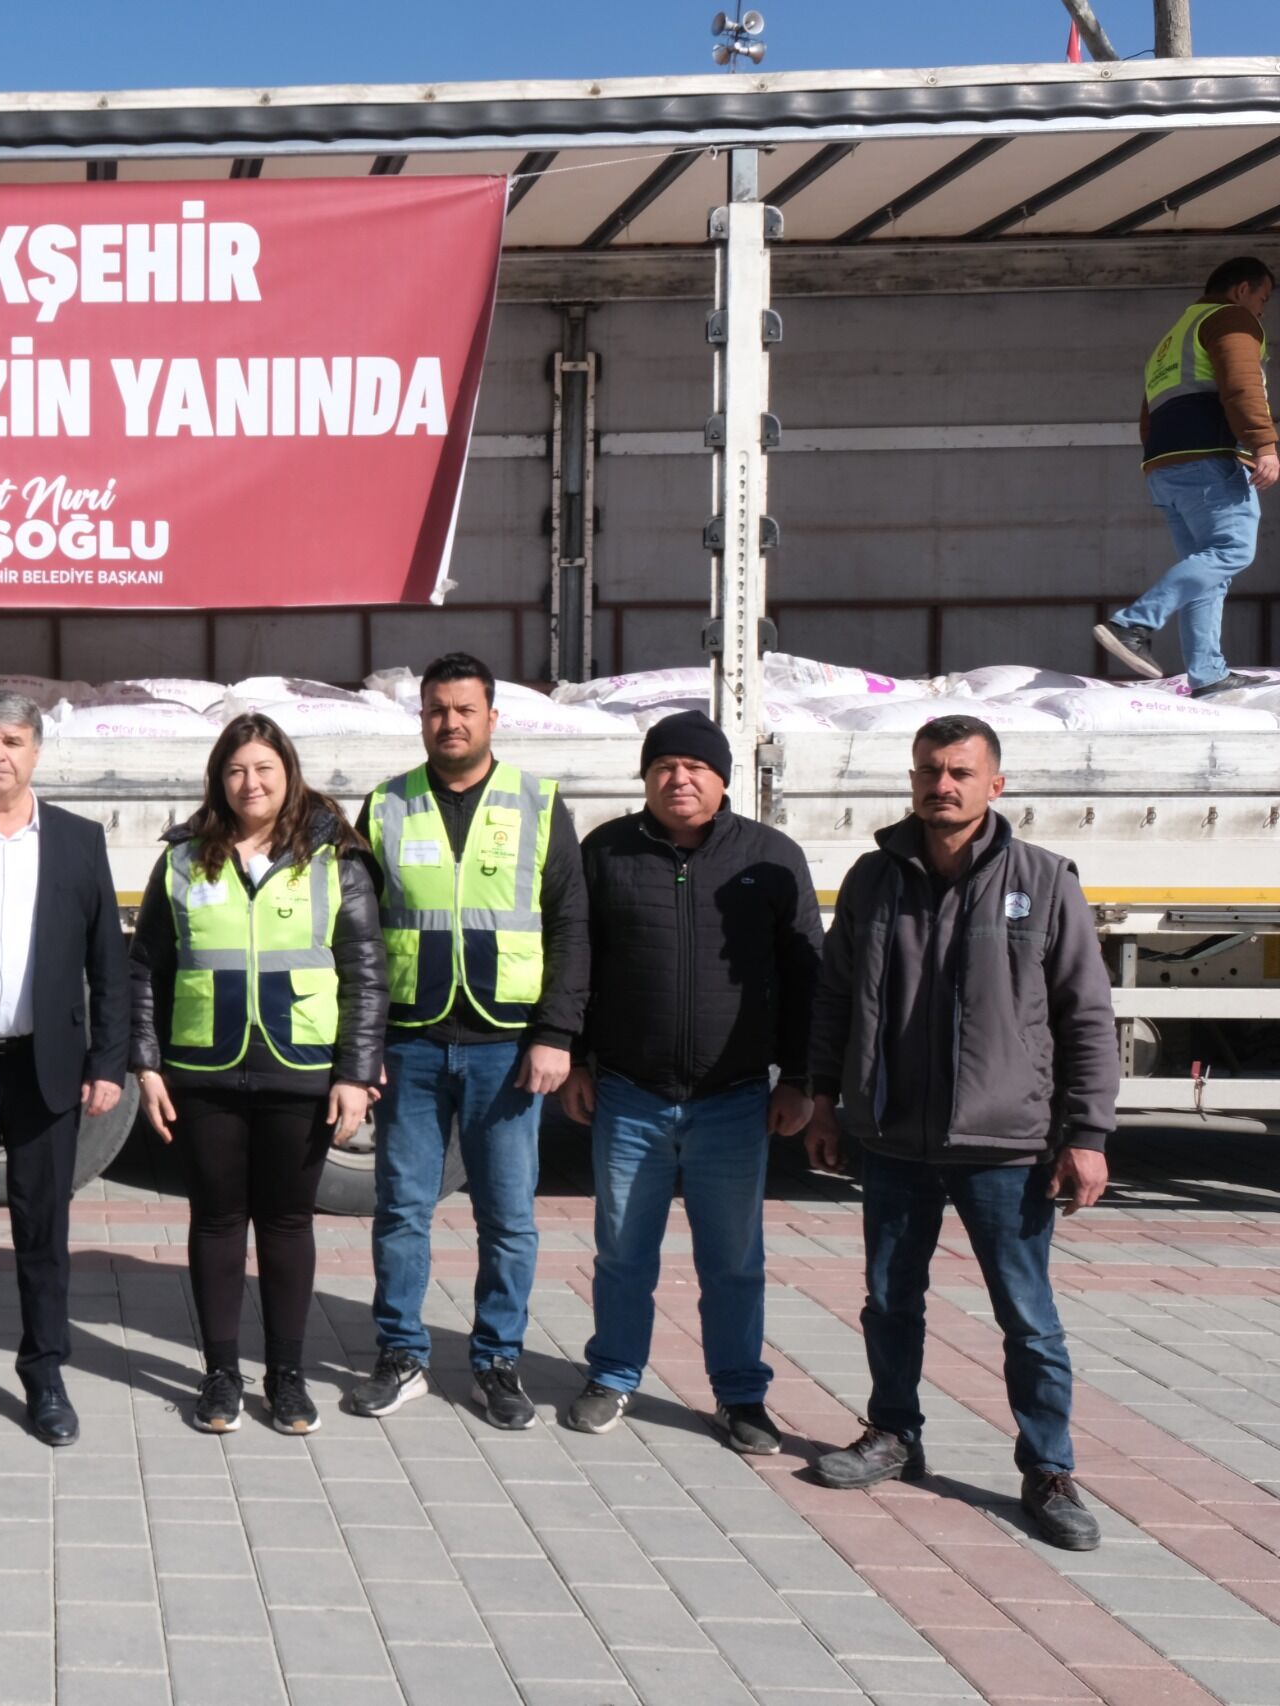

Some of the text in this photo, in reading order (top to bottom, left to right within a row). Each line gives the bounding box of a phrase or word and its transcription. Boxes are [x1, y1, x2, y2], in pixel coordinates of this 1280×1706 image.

[110, 357, 448, 437] YANINDA
[20, 474, 117, 526] Nuri
[22, 567, 94, 584] BELEDİYE
[98, 570, 163, 586] BAŞKANI
